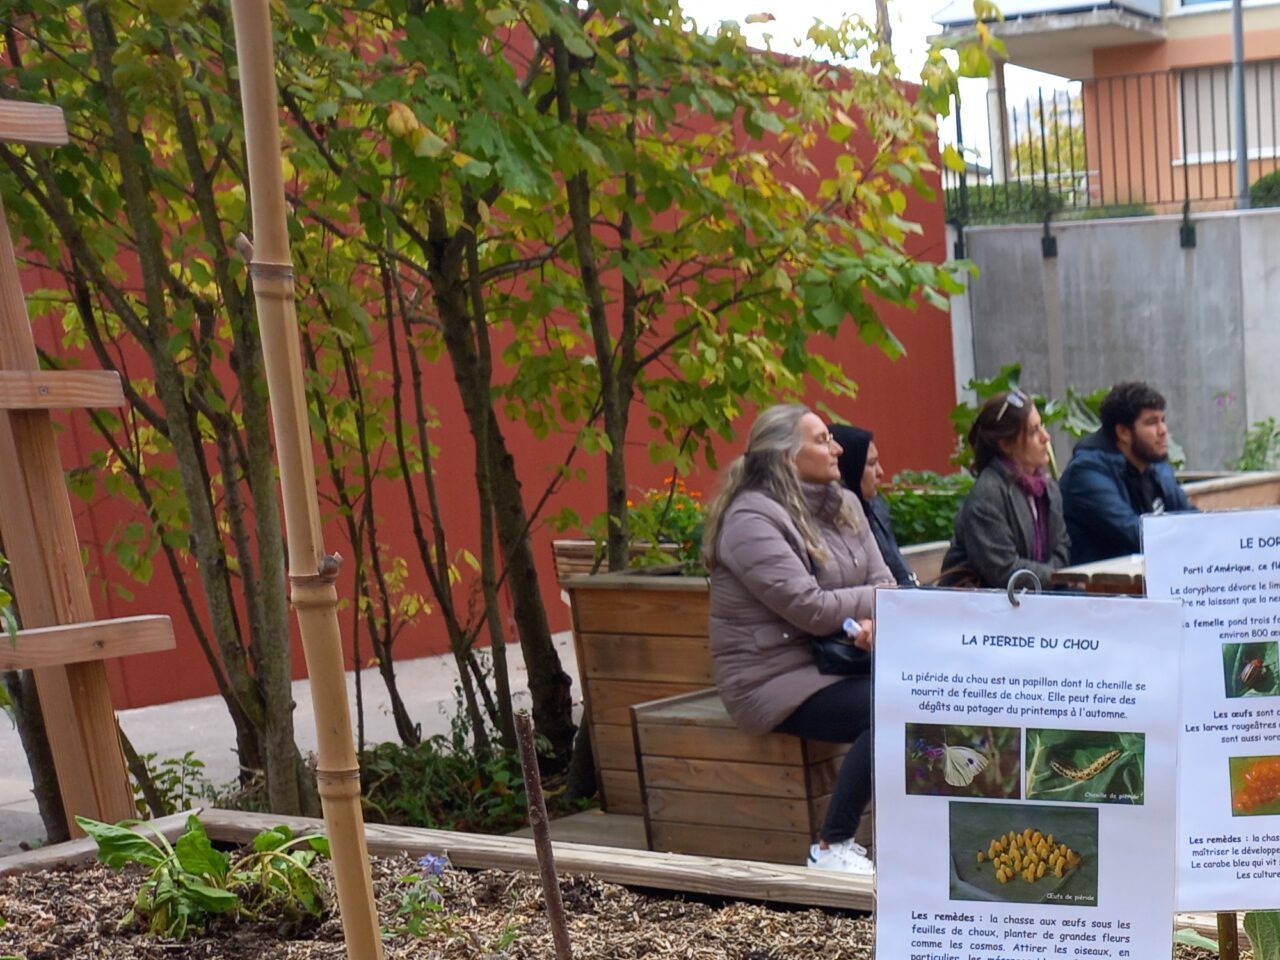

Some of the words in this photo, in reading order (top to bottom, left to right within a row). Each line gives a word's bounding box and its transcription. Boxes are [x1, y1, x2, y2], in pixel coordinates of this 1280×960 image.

[1239, 537, 1253, 549] LE
[1183, 565, 1203, 574] Parti
[1218, 630, 1249, 639] environ
[1251, 627, 1268, 638] 800
[961, 633, 977, 645] LA
[982, 634, 1035, 648] PIERIDE
[1040, 637, 1058, 648] DU
[1062, 638, 1099, 650] CHOU
[901, 671, 913, 681] La
[915, 671, 949, 684] piéride
[951, 673, 963, 683] du
[965, 673, 988, 684] chou
[990, 676, 1006, 684] est
[1008, 677, 1020, 685] un
[1022, 676, 1058, 688] papillon
[1060, 677, 1082, 688] dont
[1085, 678, 1093, 688] la
[1096, 679, 1132, 690] chenille
[1134, 682, 1146, 691] se
[911, 687, 944, 696] nourrit
[947, 687, 959, 697] de
[962, 687, 997, 699] feuilles
[999, 689, 1011, 699] de
[1014, 690, 1044, 701] choux.
[1047, 691, 1065, 702] Elle
[1067, 693, 1089, 704] peut
[1092, 693, 1116, 704] faire
[1118, 694, 1136, 704] des
[918, 700, 951, 713] dégâts
[952, 704, 964, 712] au
[966, 703, 1004, 715] potager
[1005, 703, 1018, 714] du
[1020, 705, 1068, 718] printemps
[1070, 706, 1076, 716] à
[1213, 710, 1228, 719] Les
[1230, 708, 1253, 718] œufs
[1255, 708, 1274, 717] sont
[1221, 735, 1238, 743] sont
[1240, 733, 1261, 742] aussi
[1191, 847, 1229, 856] maîtriser
[1231, 846, 1239, 855] le
[1236, 870, 1250, 879] Les
[910, 940, 942, 948] comme
[949, 939, 963, 949] les
[969, 942, 1005, 951] cosmos.
[1012, 942, 1047, 953] Attirer
[1054, 943, 1067, 954] les
[1073, 945, 1111, 957] oiseaux,
[1118, 949, 1129, 957] en
